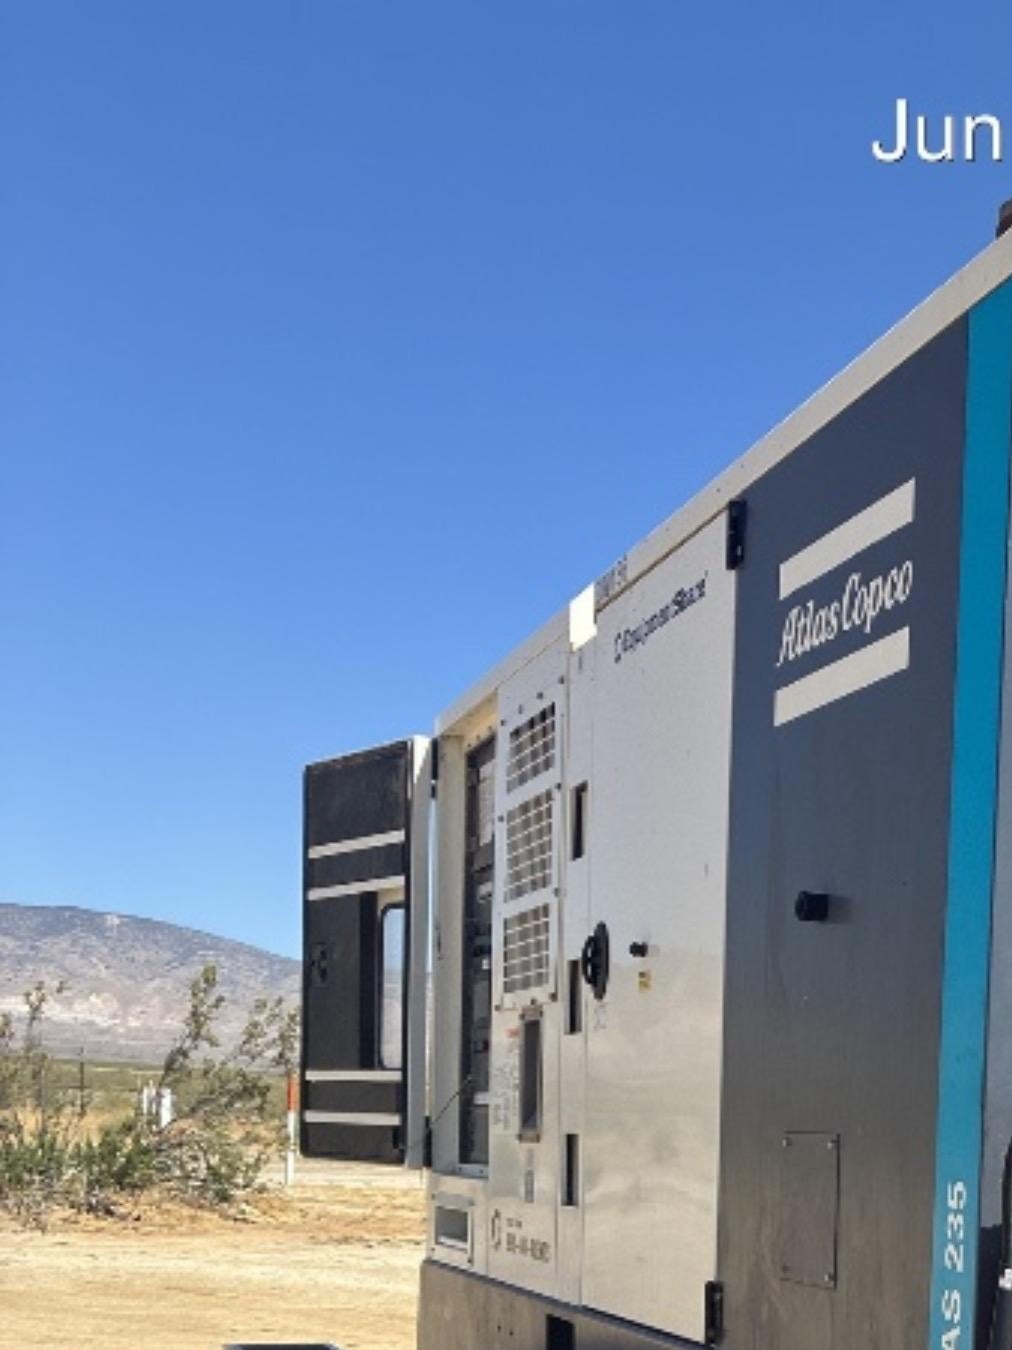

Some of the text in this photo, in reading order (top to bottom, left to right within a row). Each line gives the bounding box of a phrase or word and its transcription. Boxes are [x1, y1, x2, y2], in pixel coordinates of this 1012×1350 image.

[774, 560, 913, 668] Atlas Copco
[944, 1180, 968, 1273] 235
